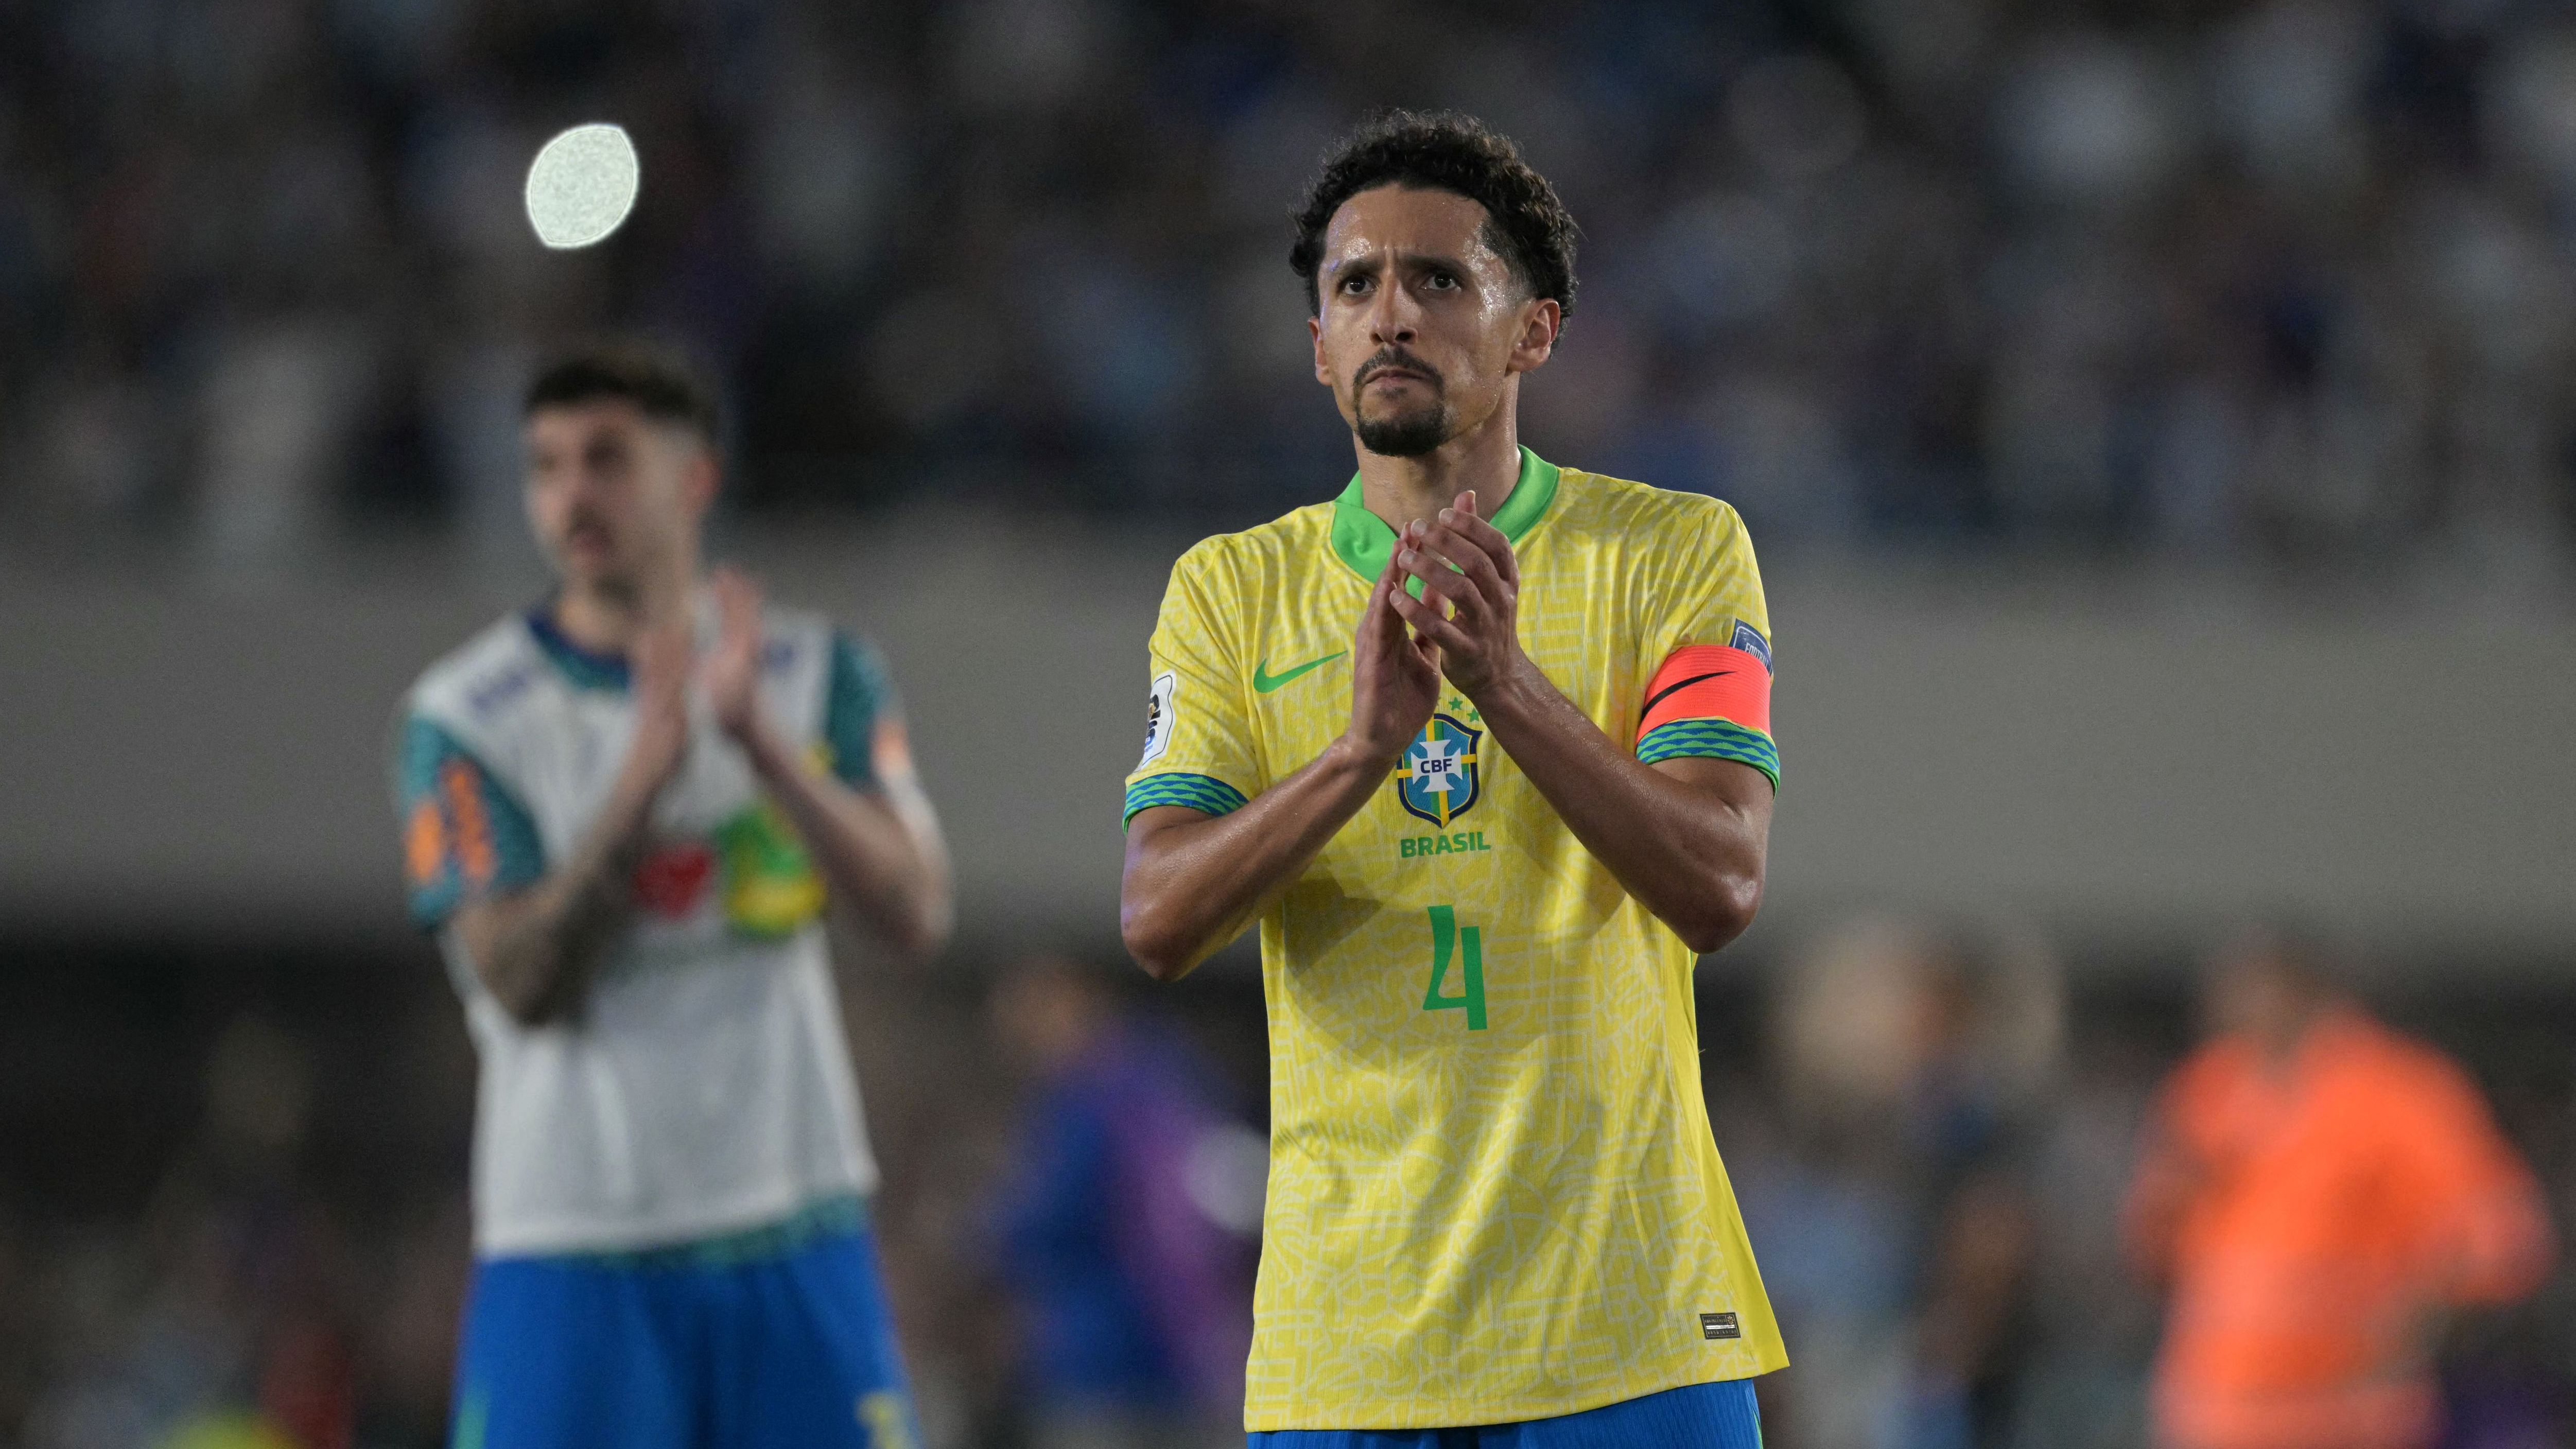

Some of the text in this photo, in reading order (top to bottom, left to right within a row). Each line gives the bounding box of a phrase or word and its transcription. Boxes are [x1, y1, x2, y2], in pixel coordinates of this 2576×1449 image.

[1420, 758, 1452, 774] CBF
[1401, 831, 1491, 858] BRASIL
[1422, 905, 1487, 1031] 4
